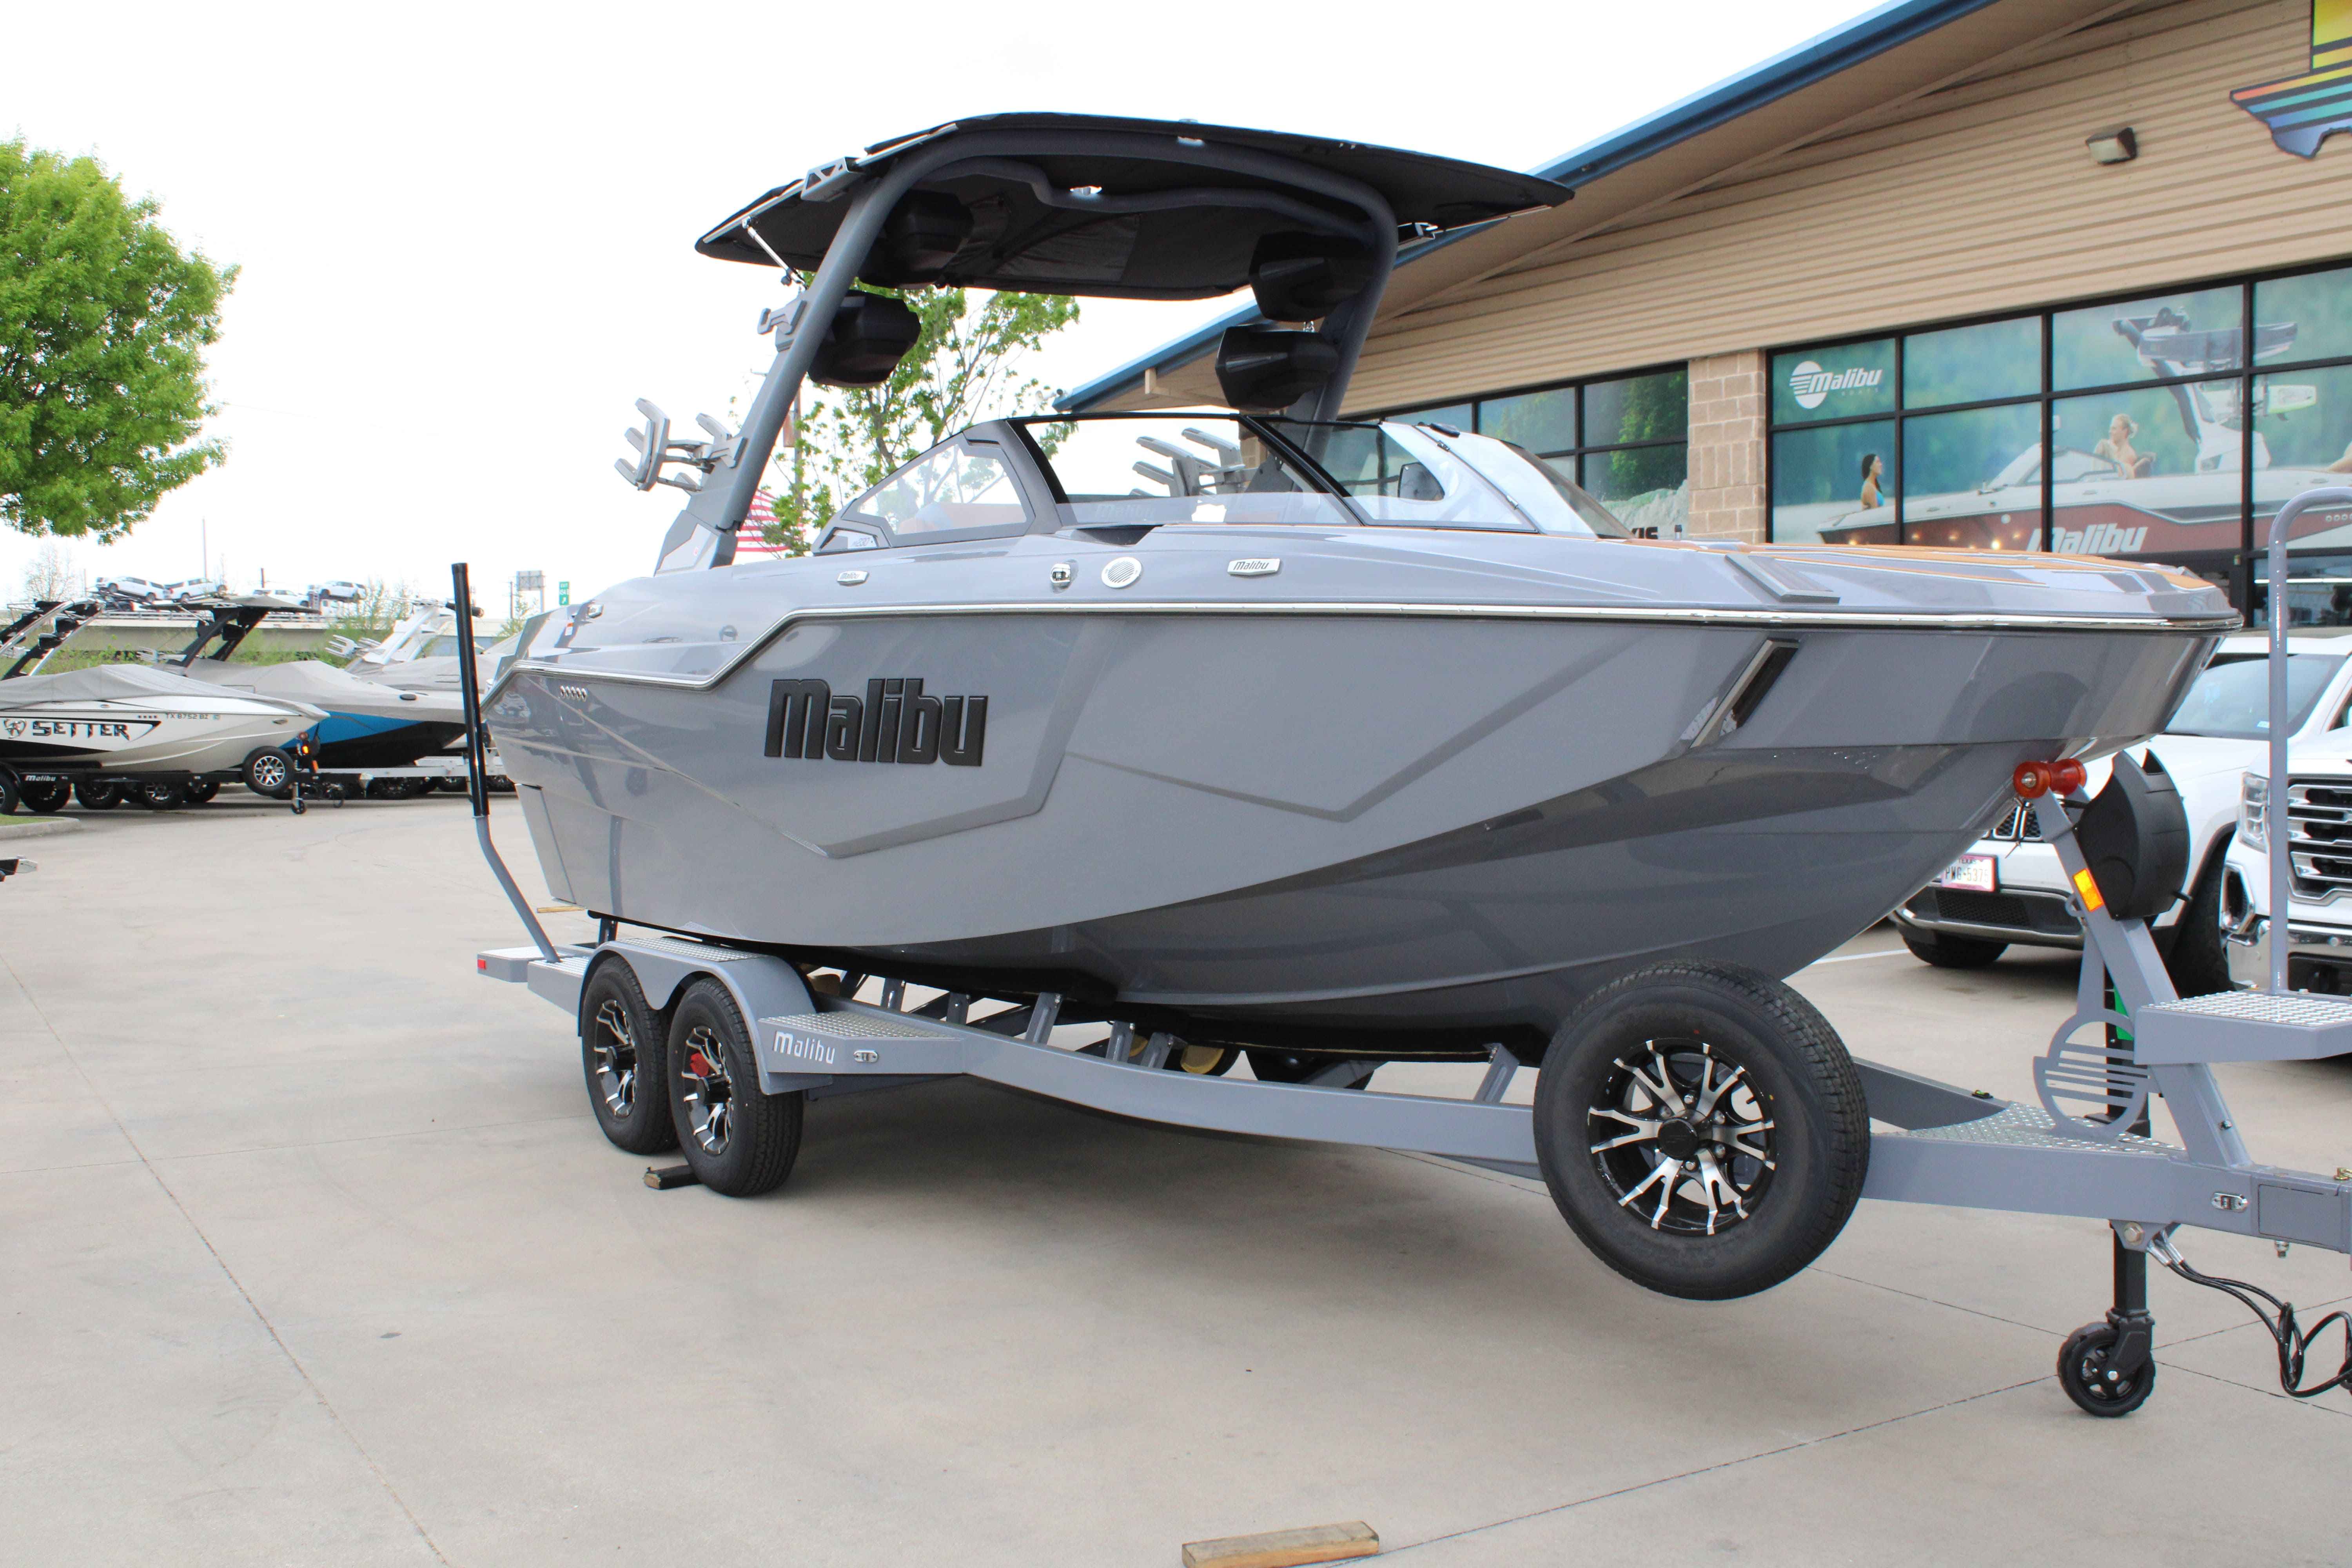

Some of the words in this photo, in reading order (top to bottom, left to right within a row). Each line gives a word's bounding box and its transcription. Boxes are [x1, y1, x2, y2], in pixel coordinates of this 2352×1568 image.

[1808, 367, 1883, 393] Malibu
[2025, 523, 2148, 555] Malibu
[1233, 561, 1269, 570] Malibu
[33, 720, 130, 741] SETTER
[764, 678, 989, 767] Malibu
[773, 1030, 835, 1065] Malibu
